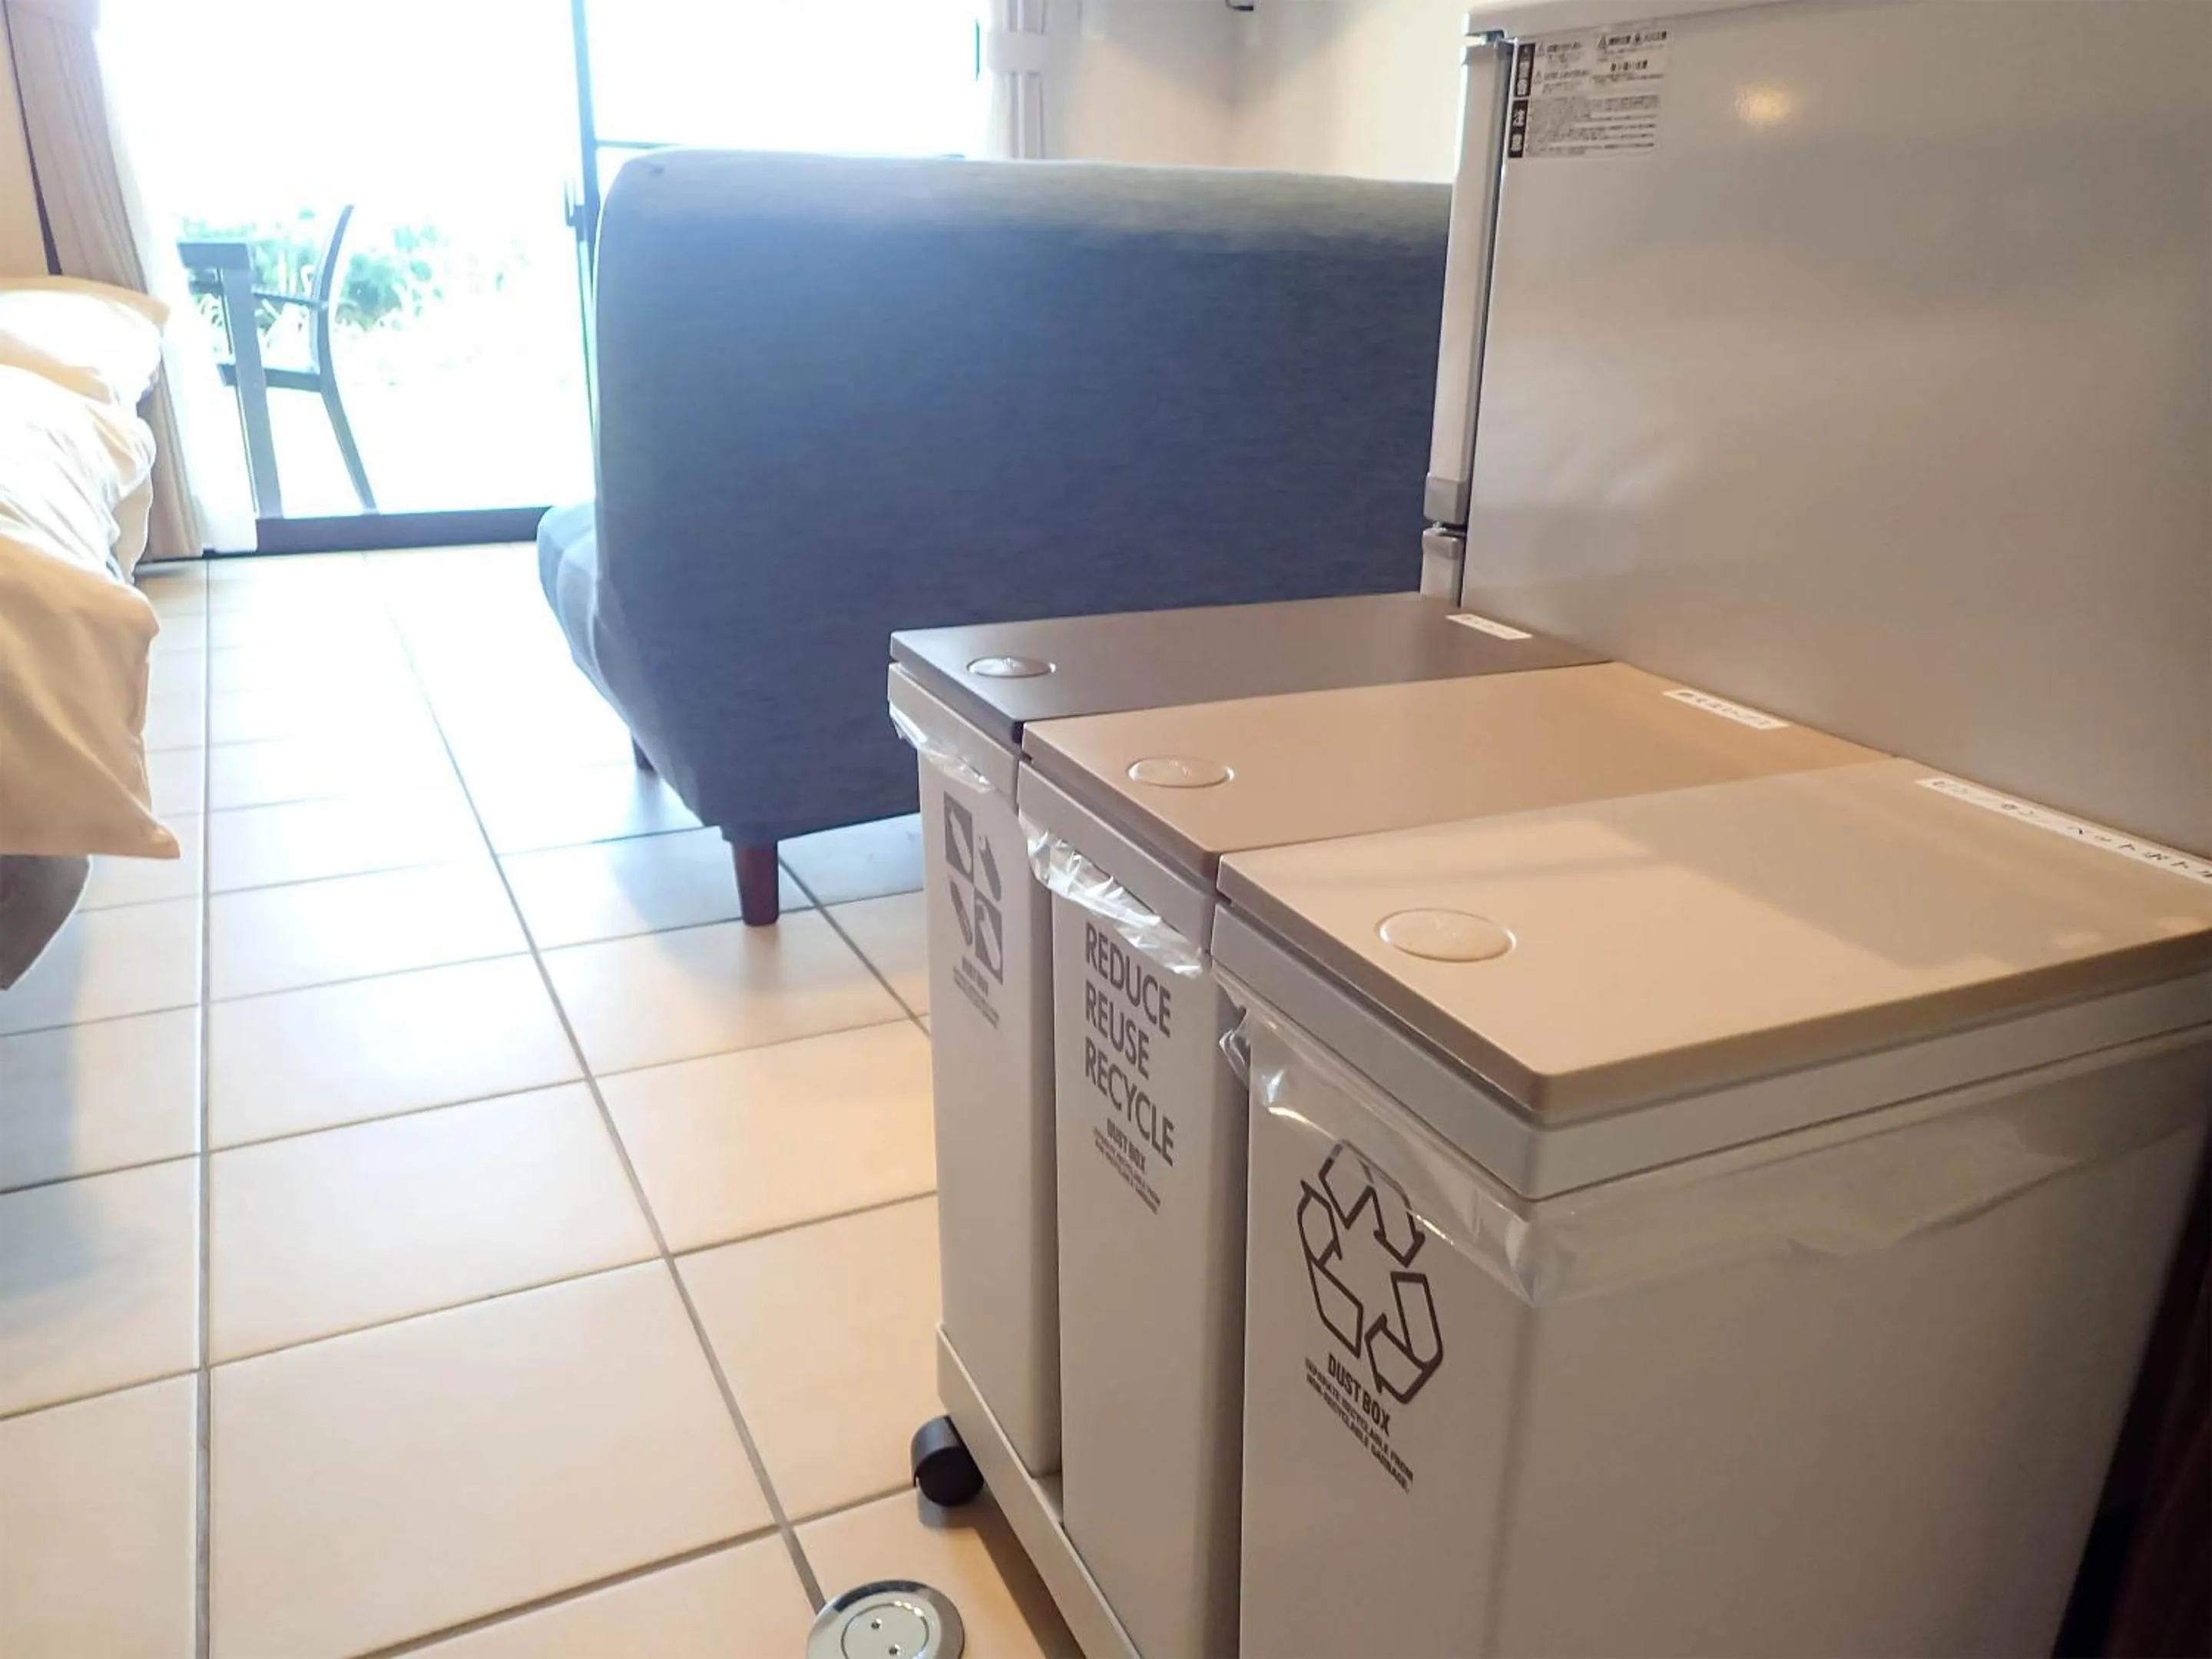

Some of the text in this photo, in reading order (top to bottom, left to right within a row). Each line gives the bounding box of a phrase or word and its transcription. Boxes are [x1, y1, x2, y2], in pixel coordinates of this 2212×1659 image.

[1086, 922, 1171, 1038] REDUCE
[1086, 979, 1149, 1080] REUSE
[1085, 1036, 1174, 1167] RECYCLE
[1328, 1353, 1390, 1438] DUST BOX
